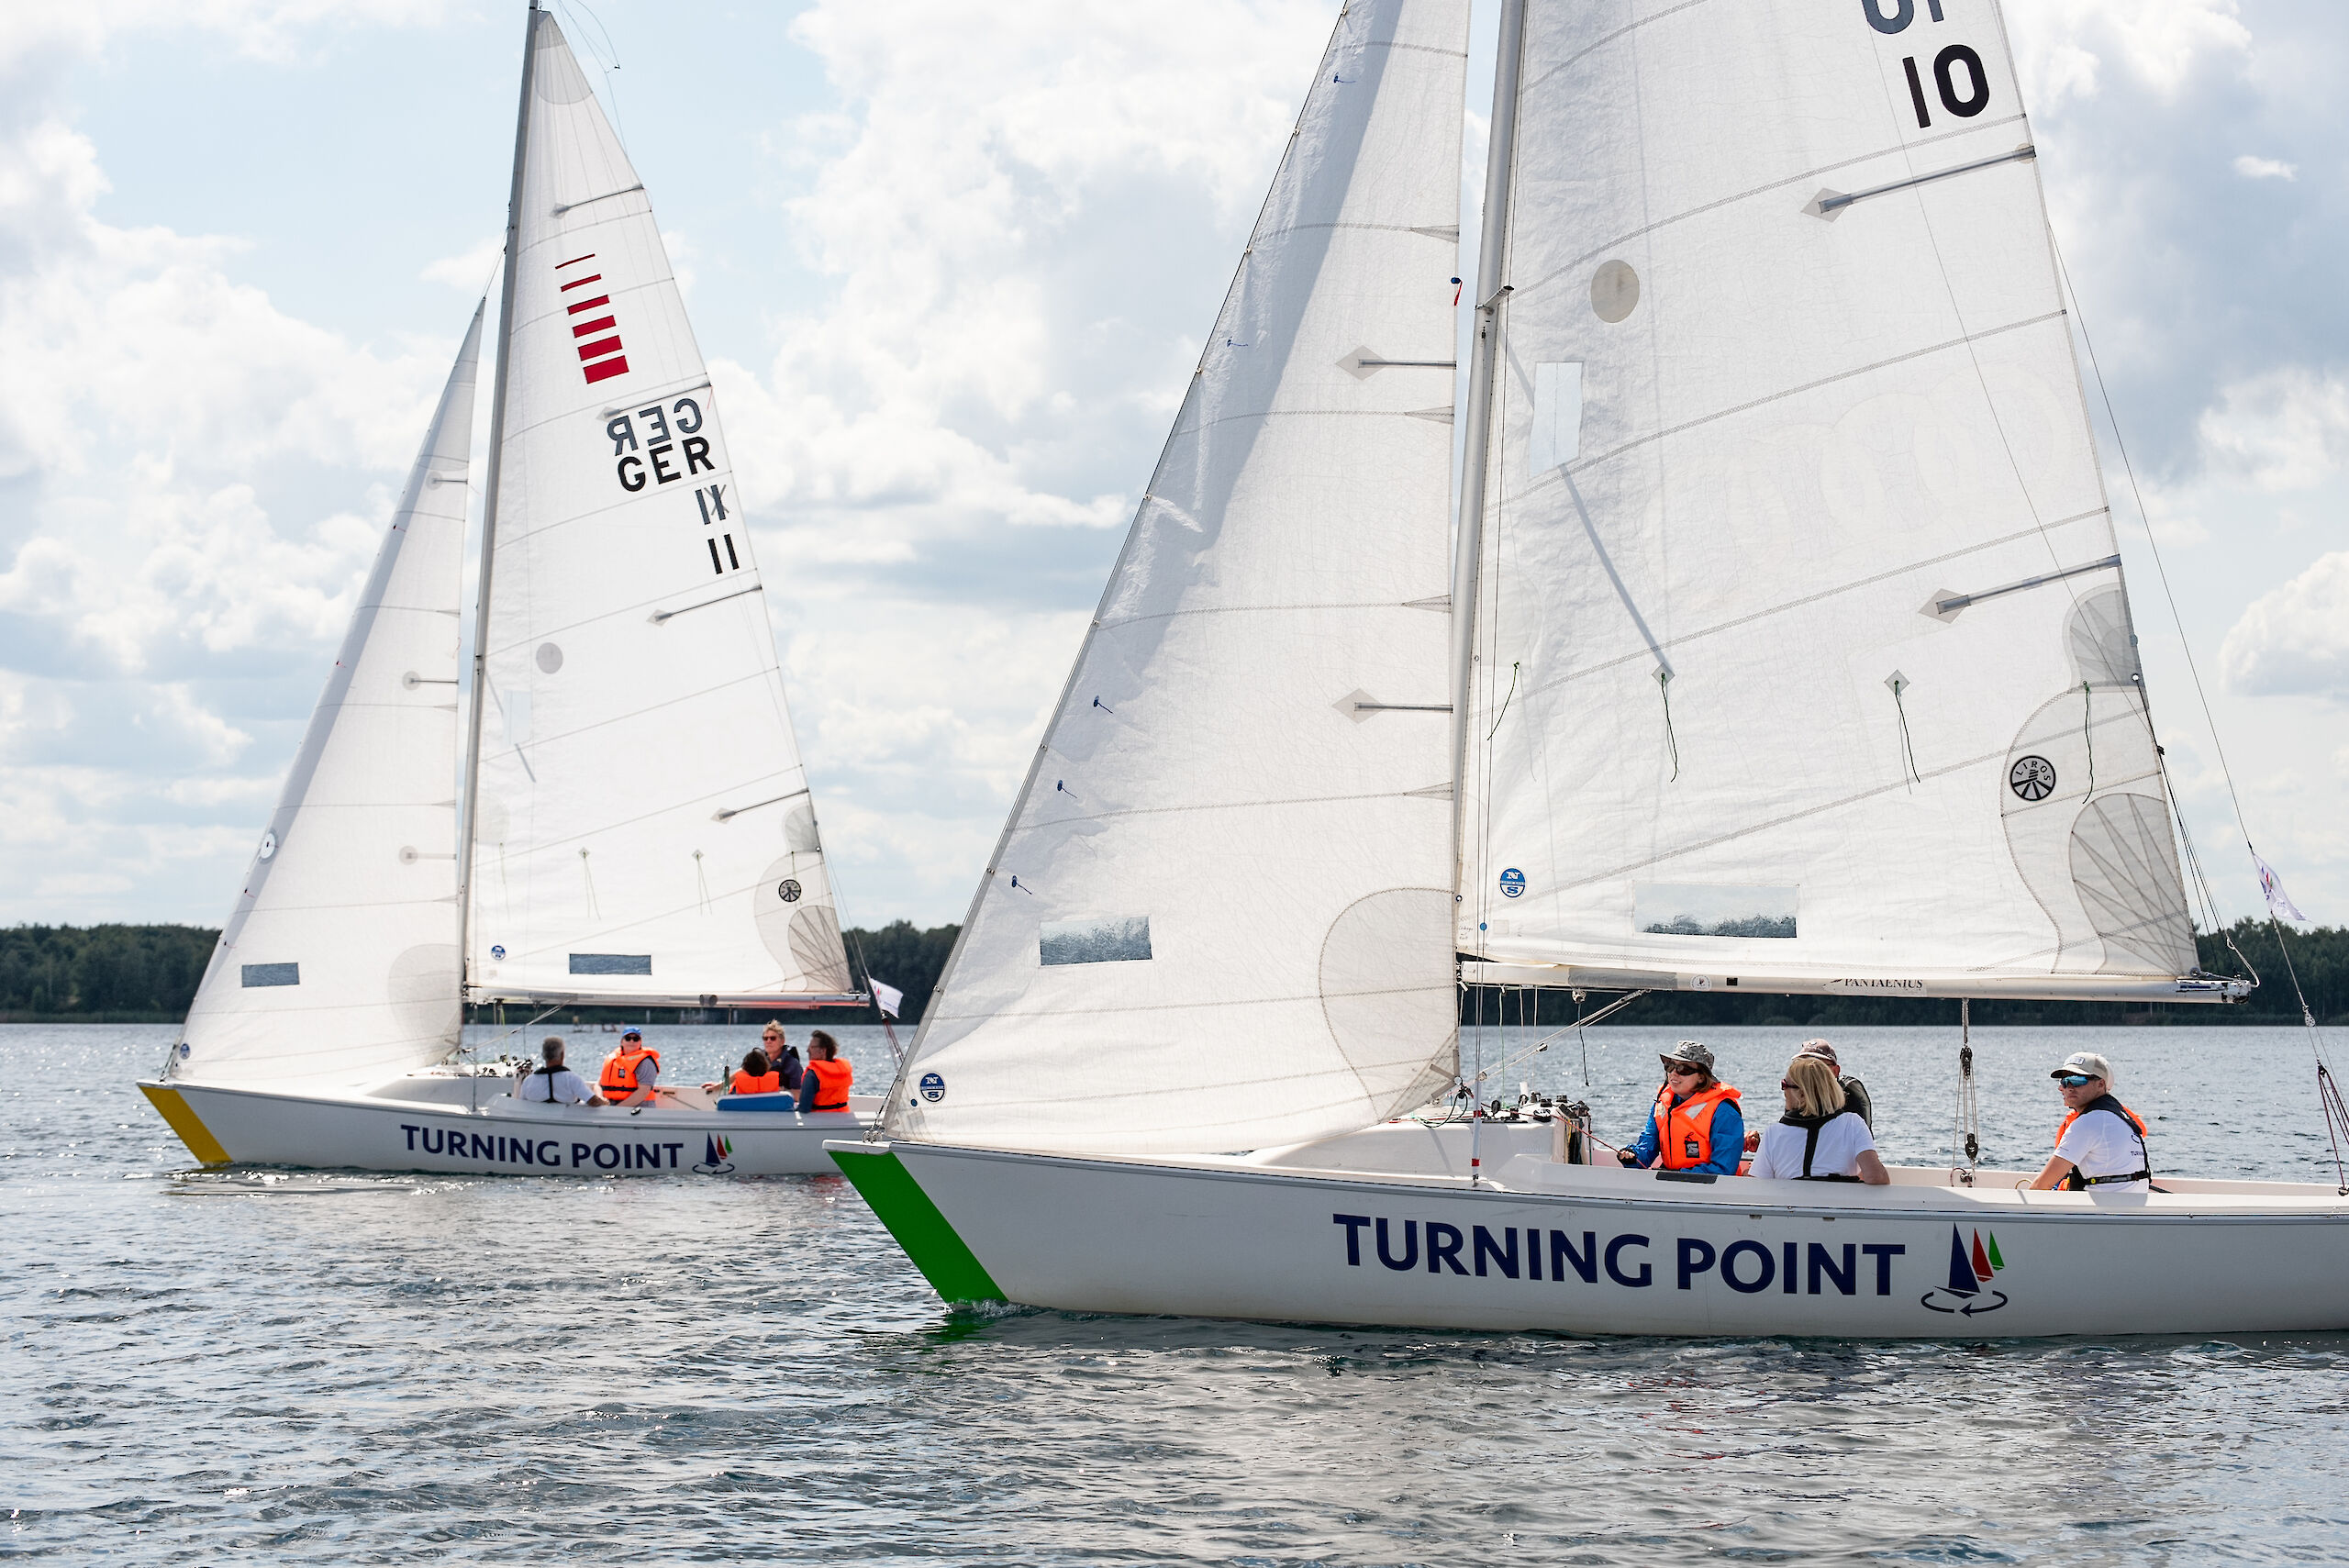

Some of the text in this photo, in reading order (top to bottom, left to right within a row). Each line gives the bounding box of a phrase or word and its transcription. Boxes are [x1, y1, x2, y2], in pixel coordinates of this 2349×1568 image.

[1902, 44, 1990, 128] 10
[617, 436, 716, 493] GER
[707, 533, 740, 575] 11
[2015, 760, 2052, 781] LIROS
[400, 1124, 685, 1170] TURNING POINT
[1332, 1213, 1906, 1296] TURNING POINT
